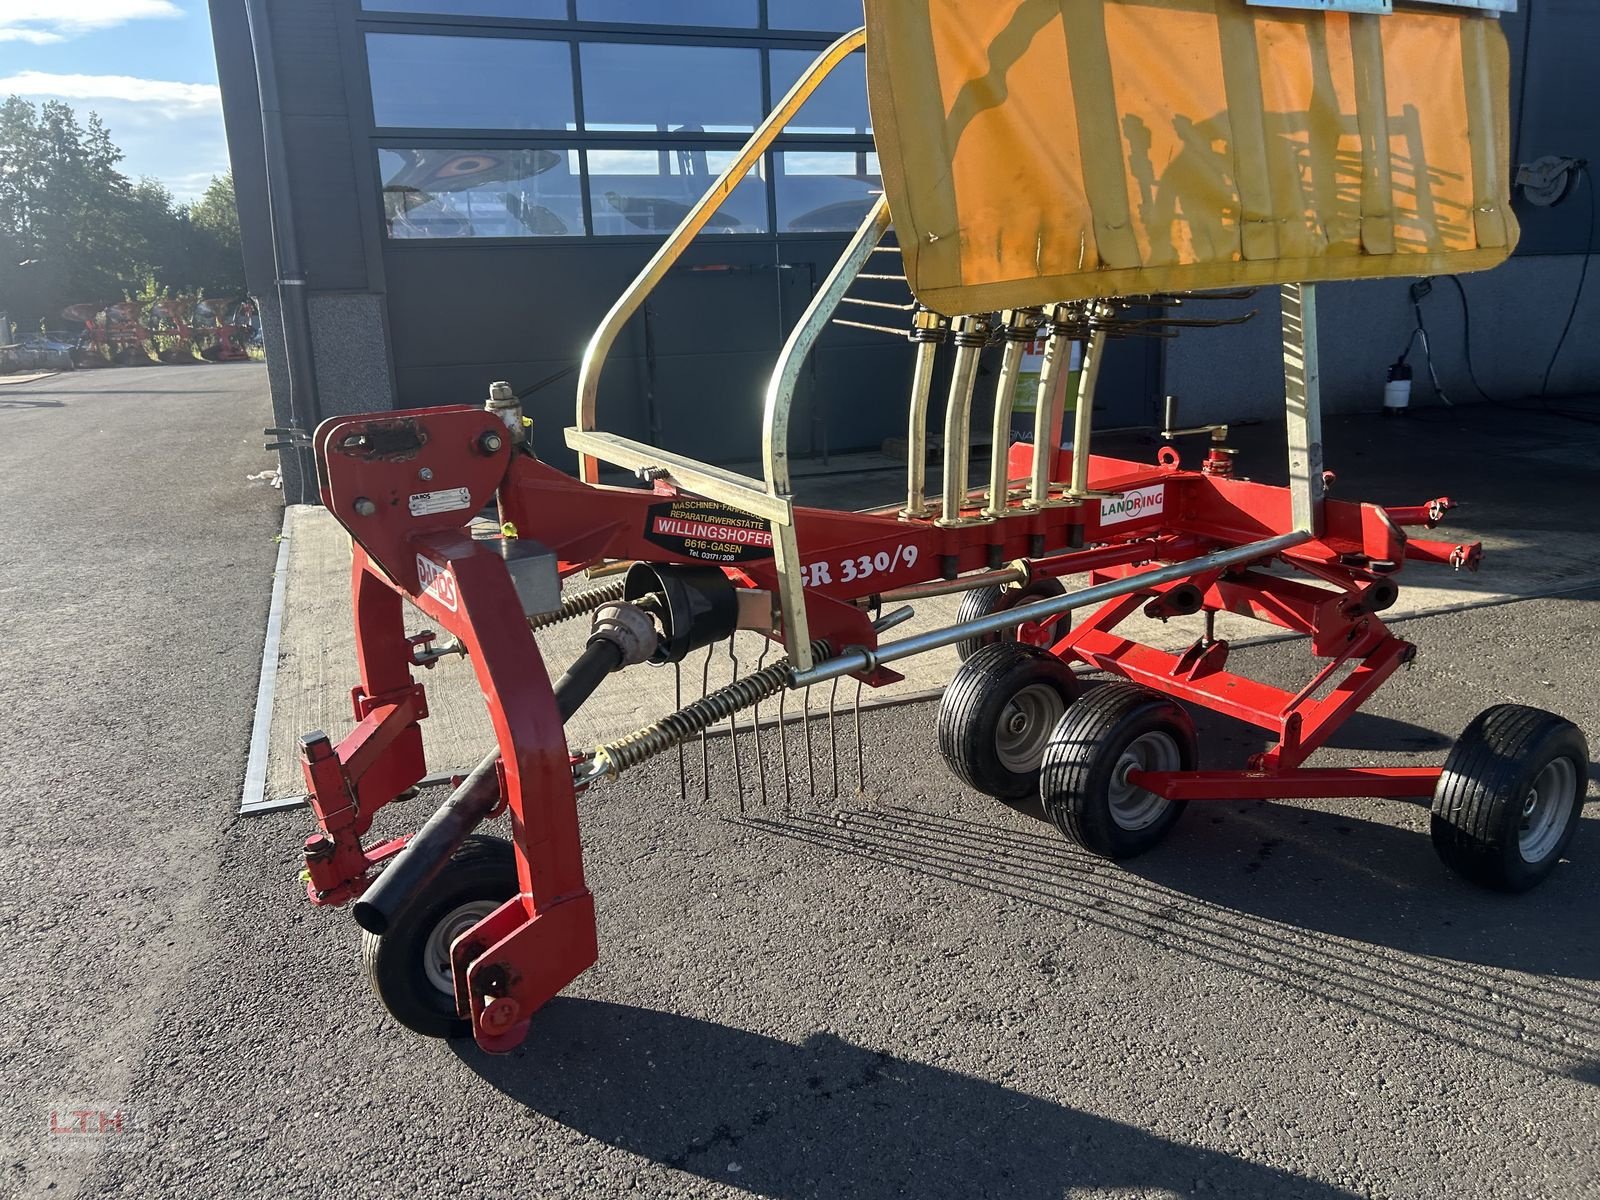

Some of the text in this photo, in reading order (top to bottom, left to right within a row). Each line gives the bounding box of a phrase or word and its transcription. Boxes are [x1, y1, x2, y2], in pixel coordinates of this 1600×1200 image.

[1101, 493, 1163, 517] LANDRING
[658, 519, 773, 546] WILLINGSHOFER
[684, 538, 743, 553] 8616-GASEN
[840, 544, 918, 583] 330/9
